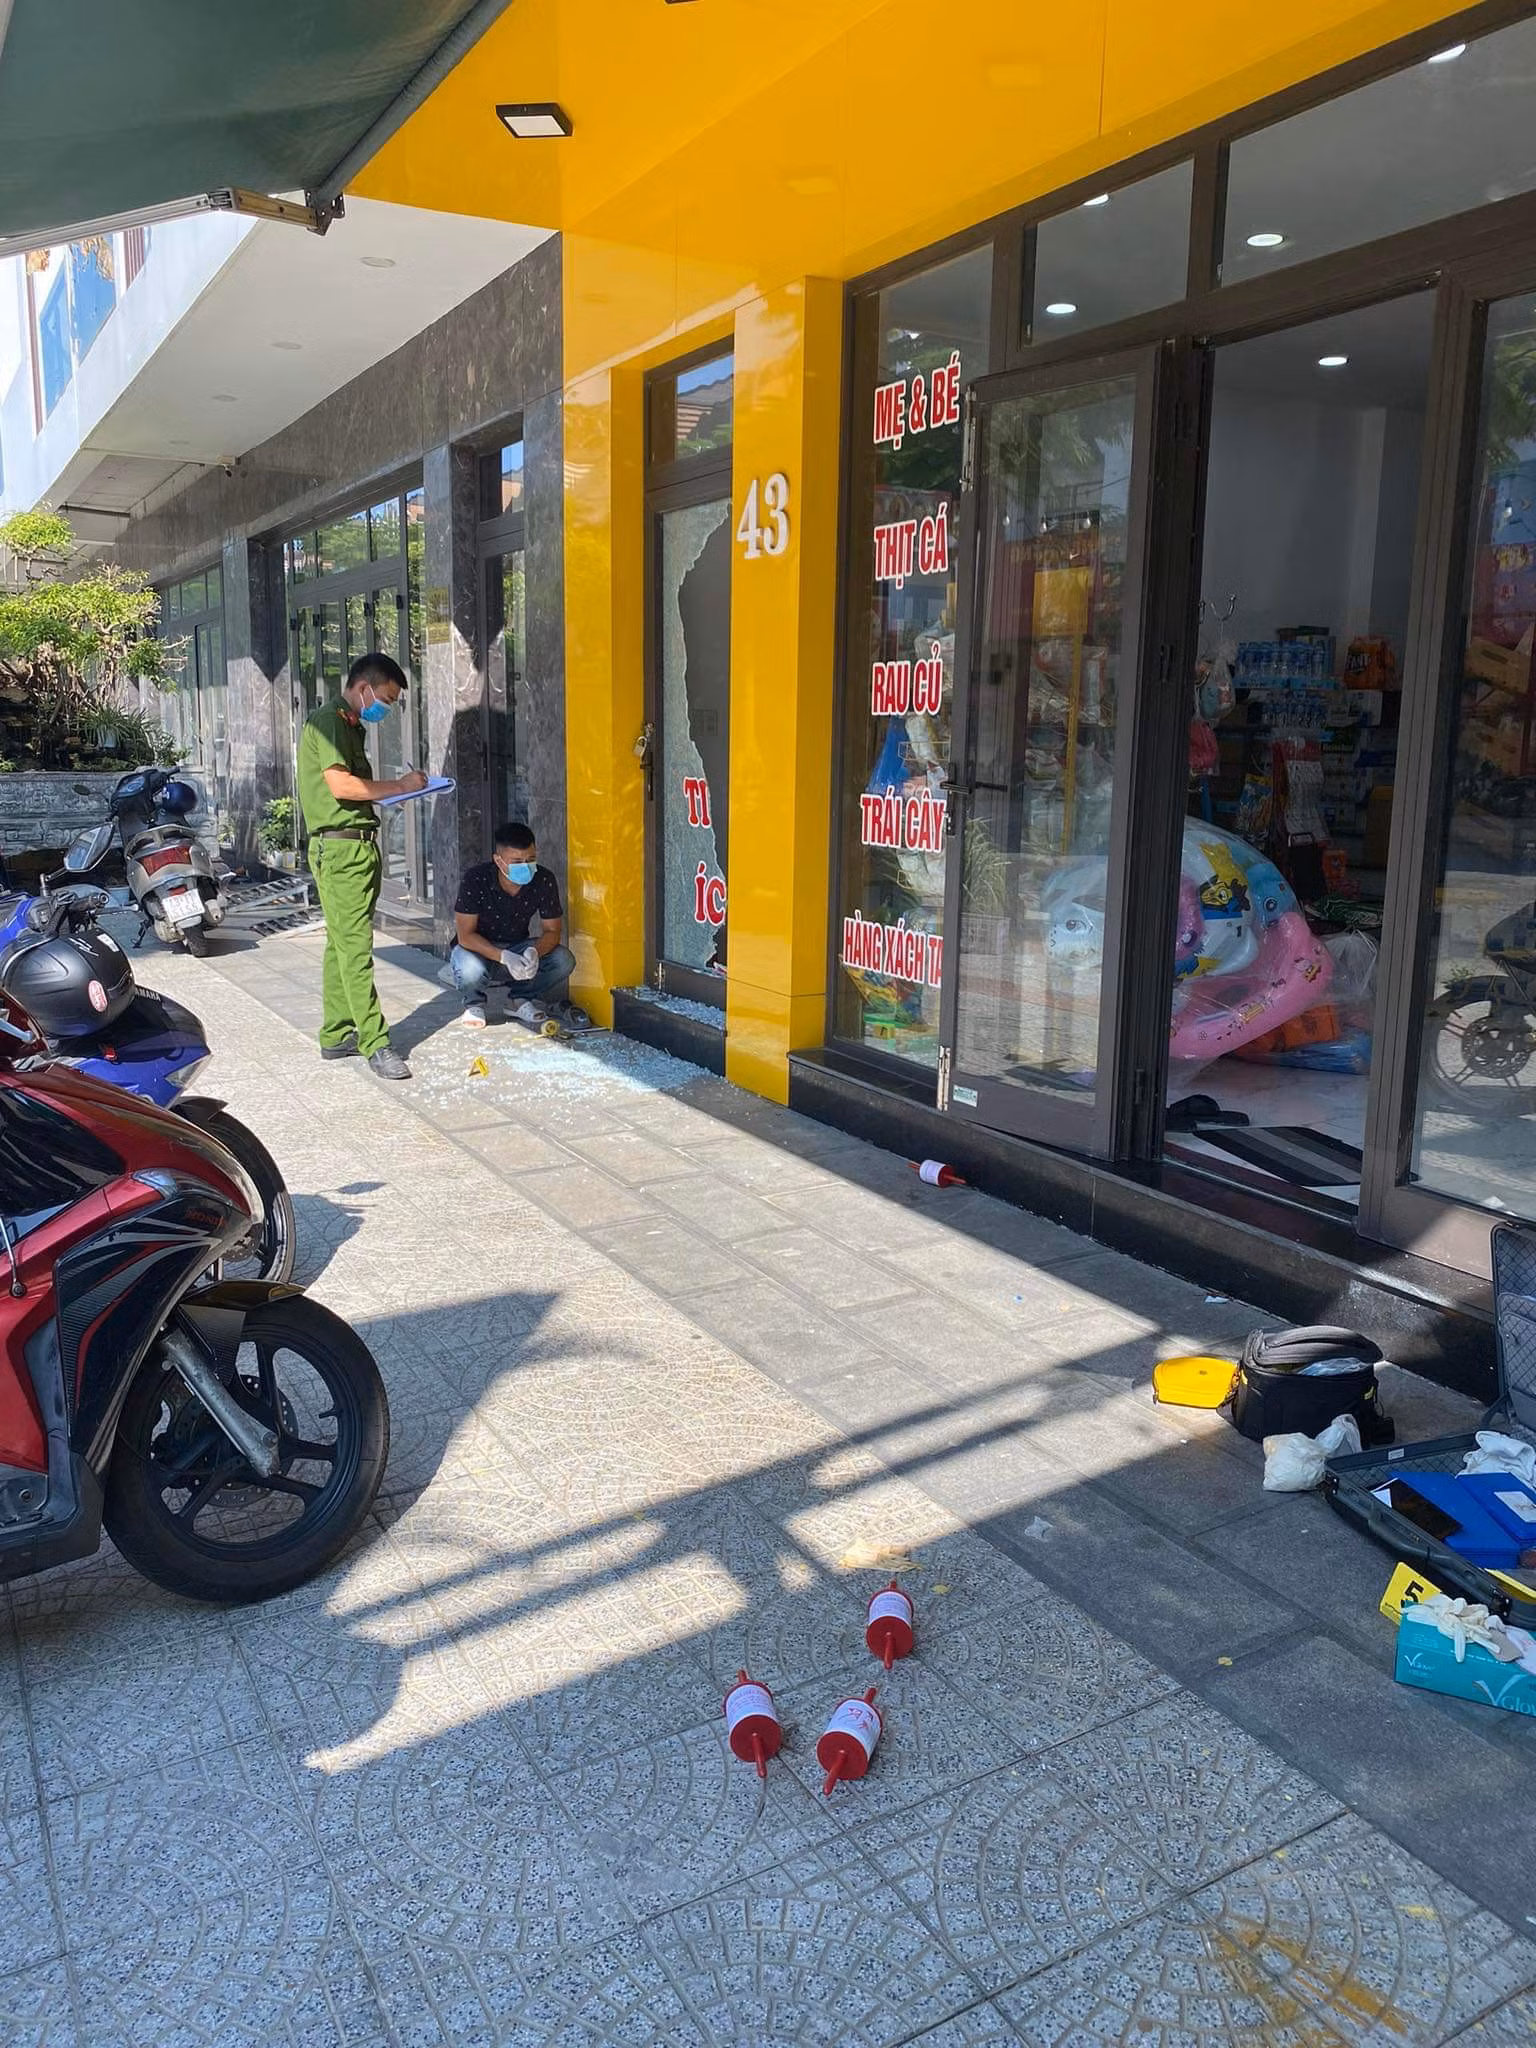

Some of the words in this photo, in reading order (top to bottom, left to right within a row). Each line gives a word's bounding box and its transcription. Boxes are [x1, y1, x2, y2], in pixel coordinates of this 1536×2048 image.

[874, 380, 906, 450] MẸ
[909, 374, 926, 434] &
[930, 350, 960, 429] BÉ
[736, 471, 790, 559] 43
[874, 519, 918, 590] THỊT
[918, 501, 949, 575] CÁ
[871, 660, 911, 716] RAU
[912, 641, 943, 715] CỦ
[860, 785, 903, 849] TRÁI
[905, 788, 947, 853] CÂY
[843, 909, 883, 973] HÀNG
[884, 917, 926, 985] XÁCH
[135, 987, 161, 1001] AMAHA
[1401, 1580, 1425, 1608] 5
